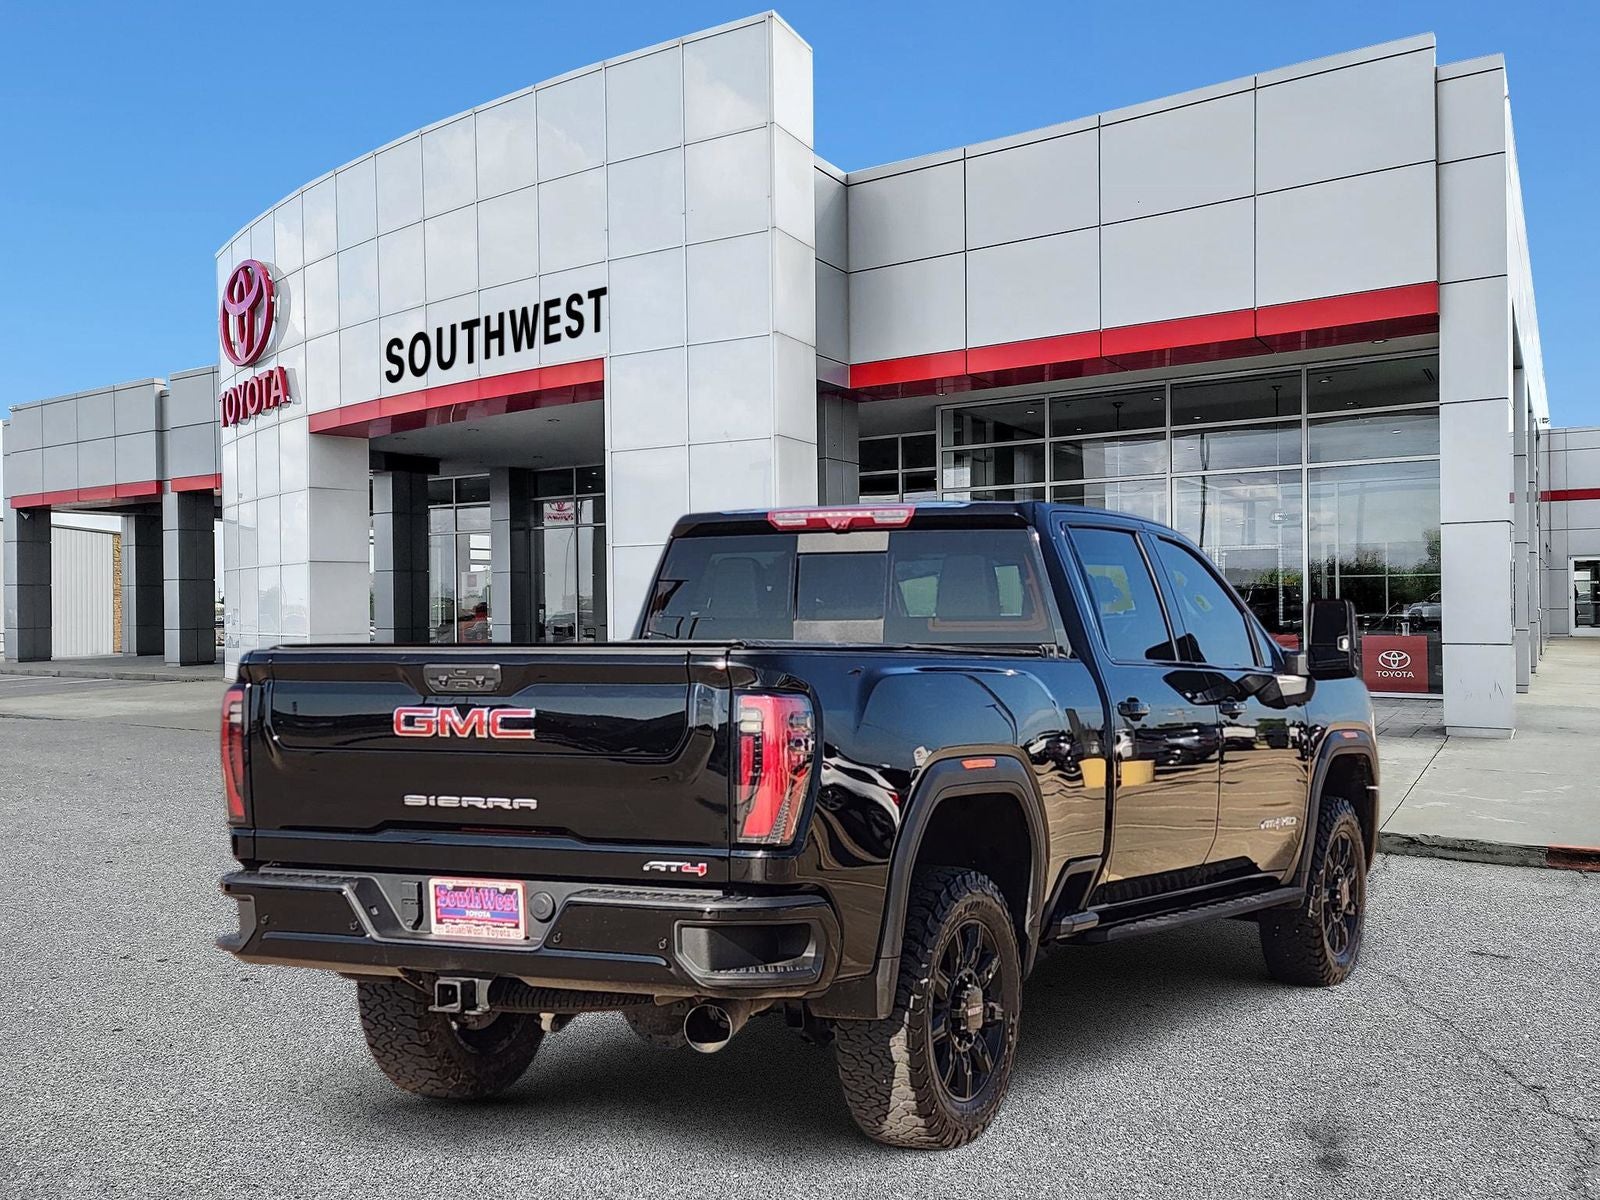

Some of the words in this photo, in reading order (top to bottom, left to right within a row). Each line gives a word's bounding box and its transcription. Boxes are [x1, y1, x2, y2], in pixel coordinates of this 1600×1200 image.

[385, 287, 607, 383] SOUTHWEST
[218, 366, 292, 427] TOYOTA
[1376, 670, 1415, 678] TOYOTA
[393, 706, 536, 739] GMC
[404, 795, 537, 810] SIERRA
[642, 860, 708, 877] AT4
[465, 910, 491, 918] TOYOTA
